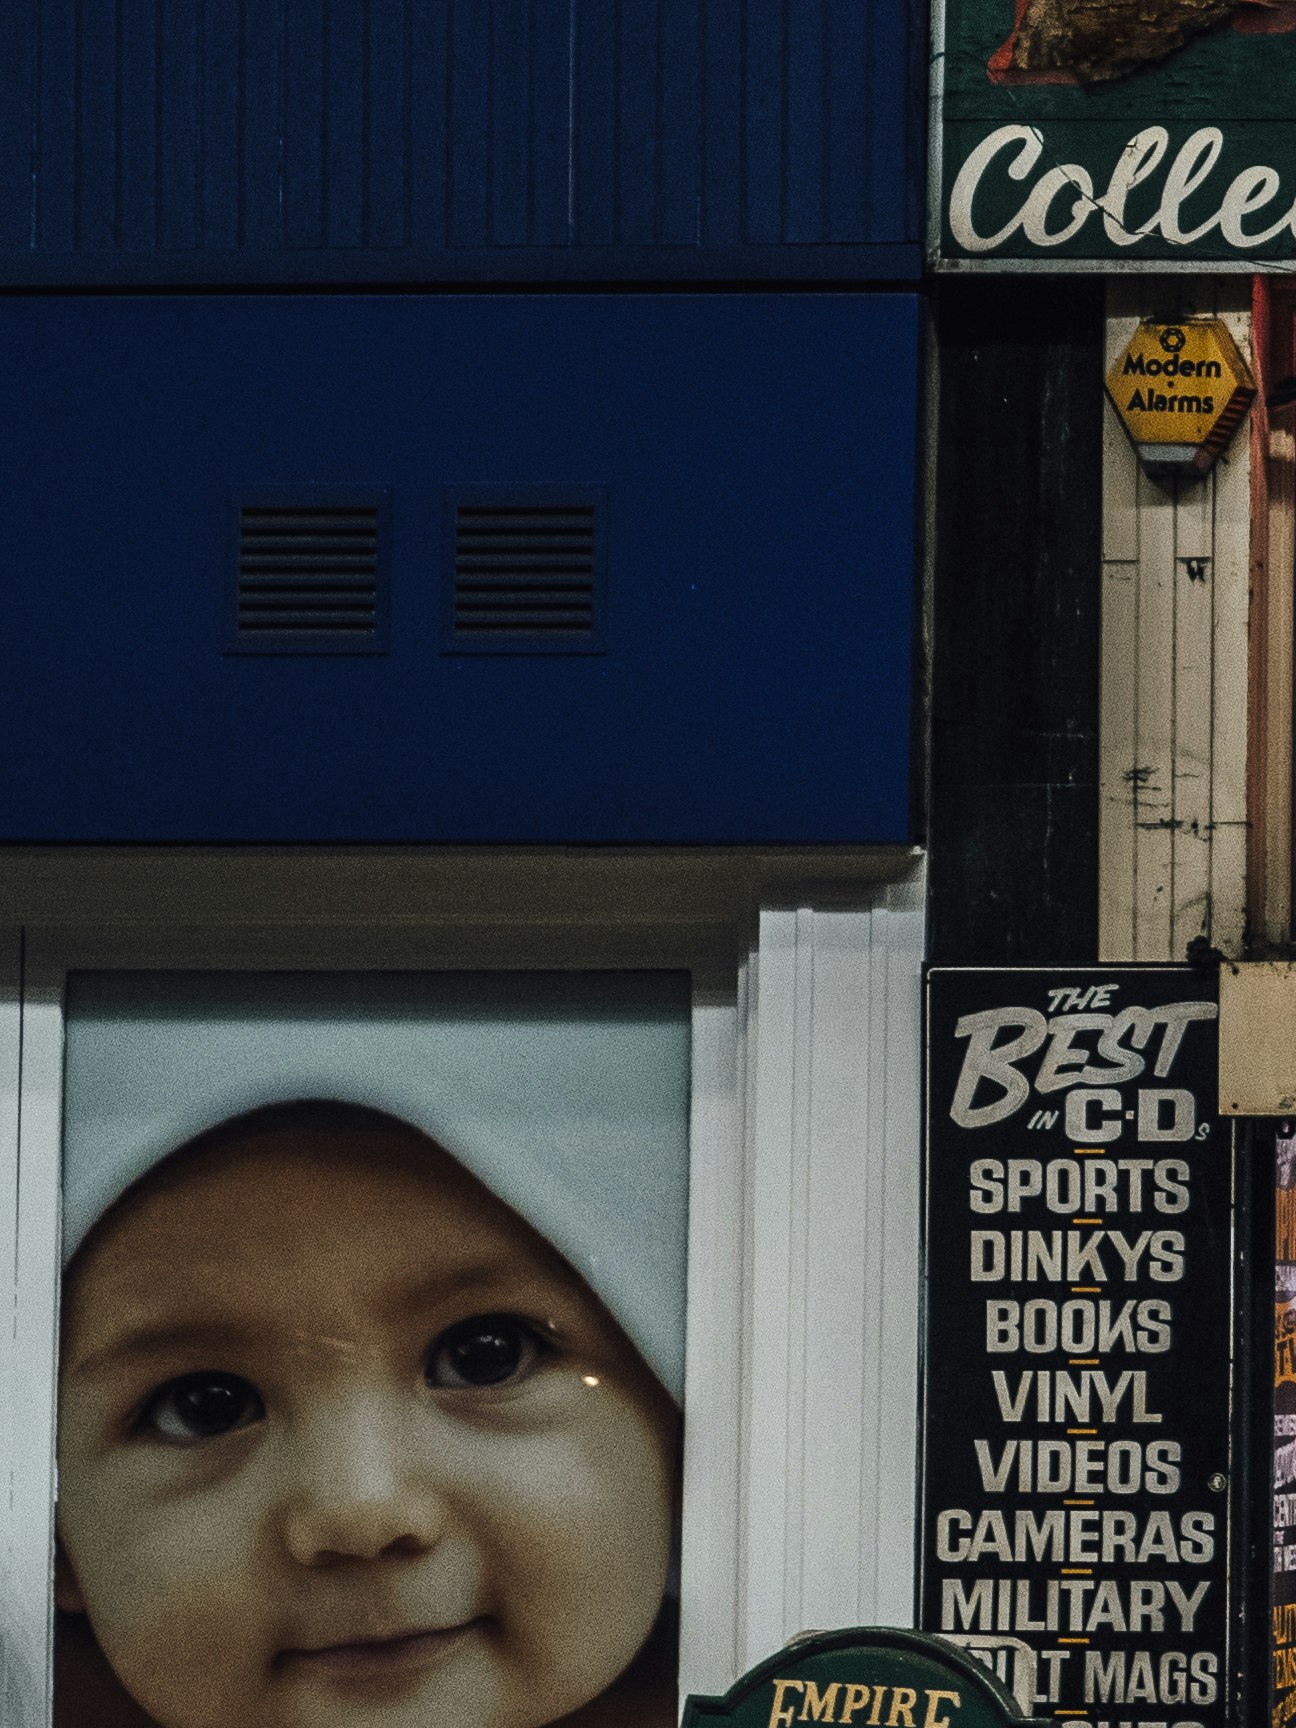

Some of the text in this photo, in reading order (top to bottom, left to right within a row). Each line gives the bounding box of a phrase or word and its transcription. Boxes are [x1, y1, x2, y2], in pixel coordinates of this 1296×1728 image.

[1122, 351, 1222, 378] Modern
[1126, 387, 1214, 414] Alarms
[1047, 984, 1119, 1012] THE
[950, 1001, 1218, 1129] BEST
[1027, 1110, 1059, 1132] IN
[969, 1159, 1190, 1214] SPORTS
[970, 1230, 1185, 1282] DINKYS
[986, 1299, 1172, 1353] BOOKS
[991, 1370, 1163, 1423] VINYL
[974, 1440, 1182, 1494] VIDEOS
[936, 1510, 1216, 1564] CAMERAS
[941, 1579, 1211, 1633] MILITARY
[1085, 1651, 1218, 1705] MAGS
